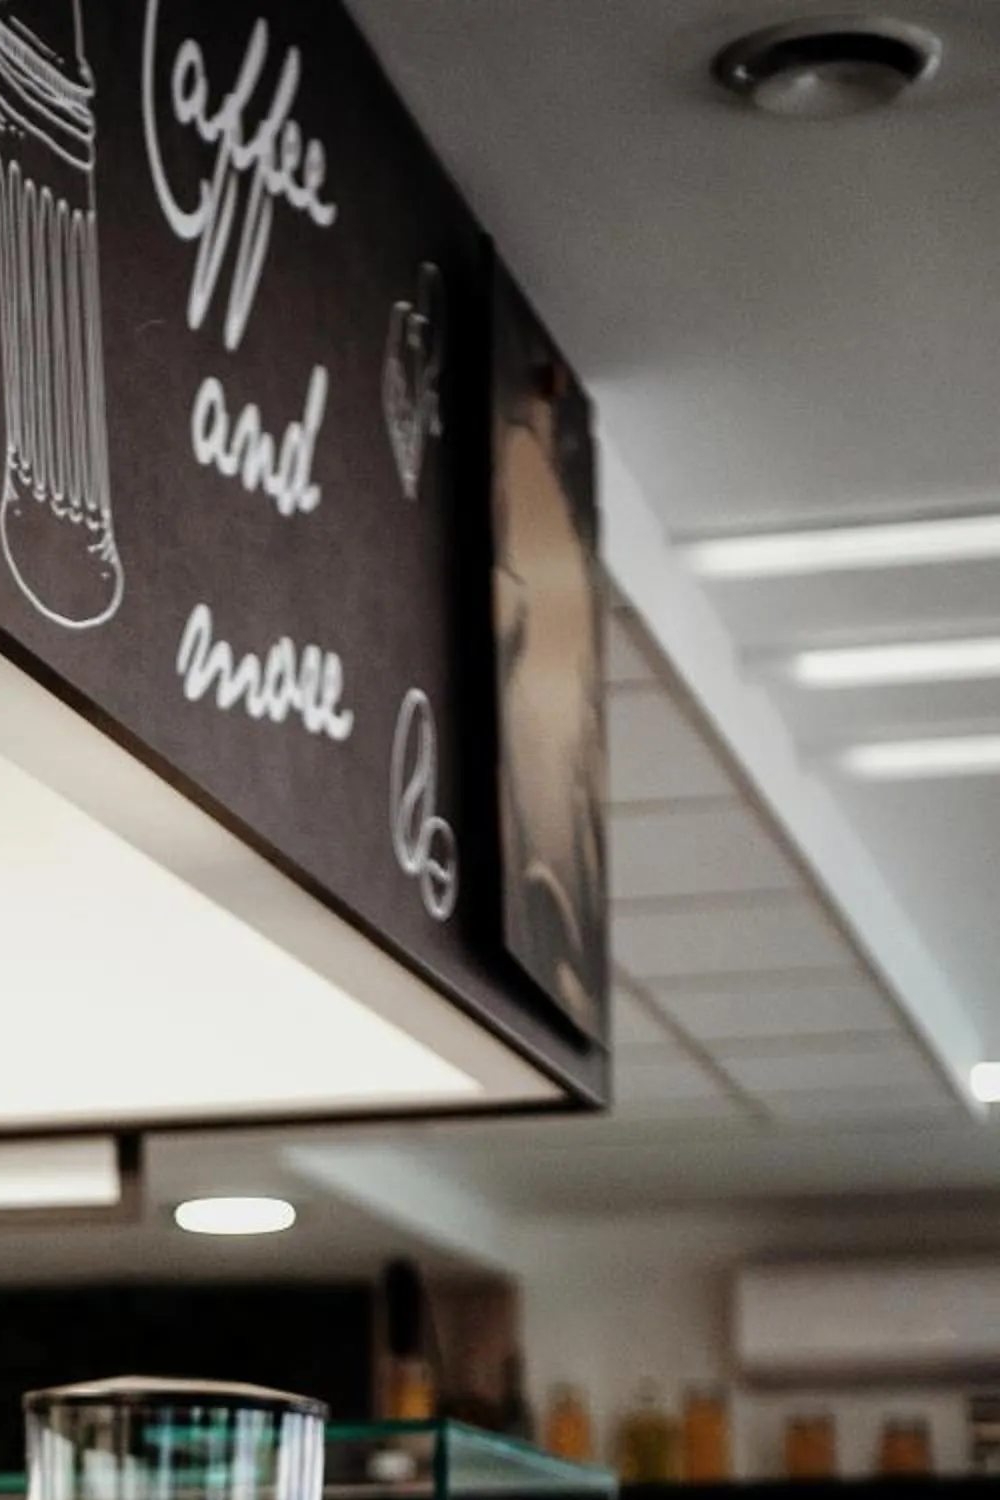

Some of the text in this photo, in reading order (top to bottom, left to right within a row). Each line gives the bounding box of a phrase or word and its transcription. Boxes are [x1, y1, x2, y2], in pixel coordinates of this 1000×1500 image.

[143, 0, 337, 352] Coffee
[192, 363, 329, 516] and
[176, 602, 354, 741] more
